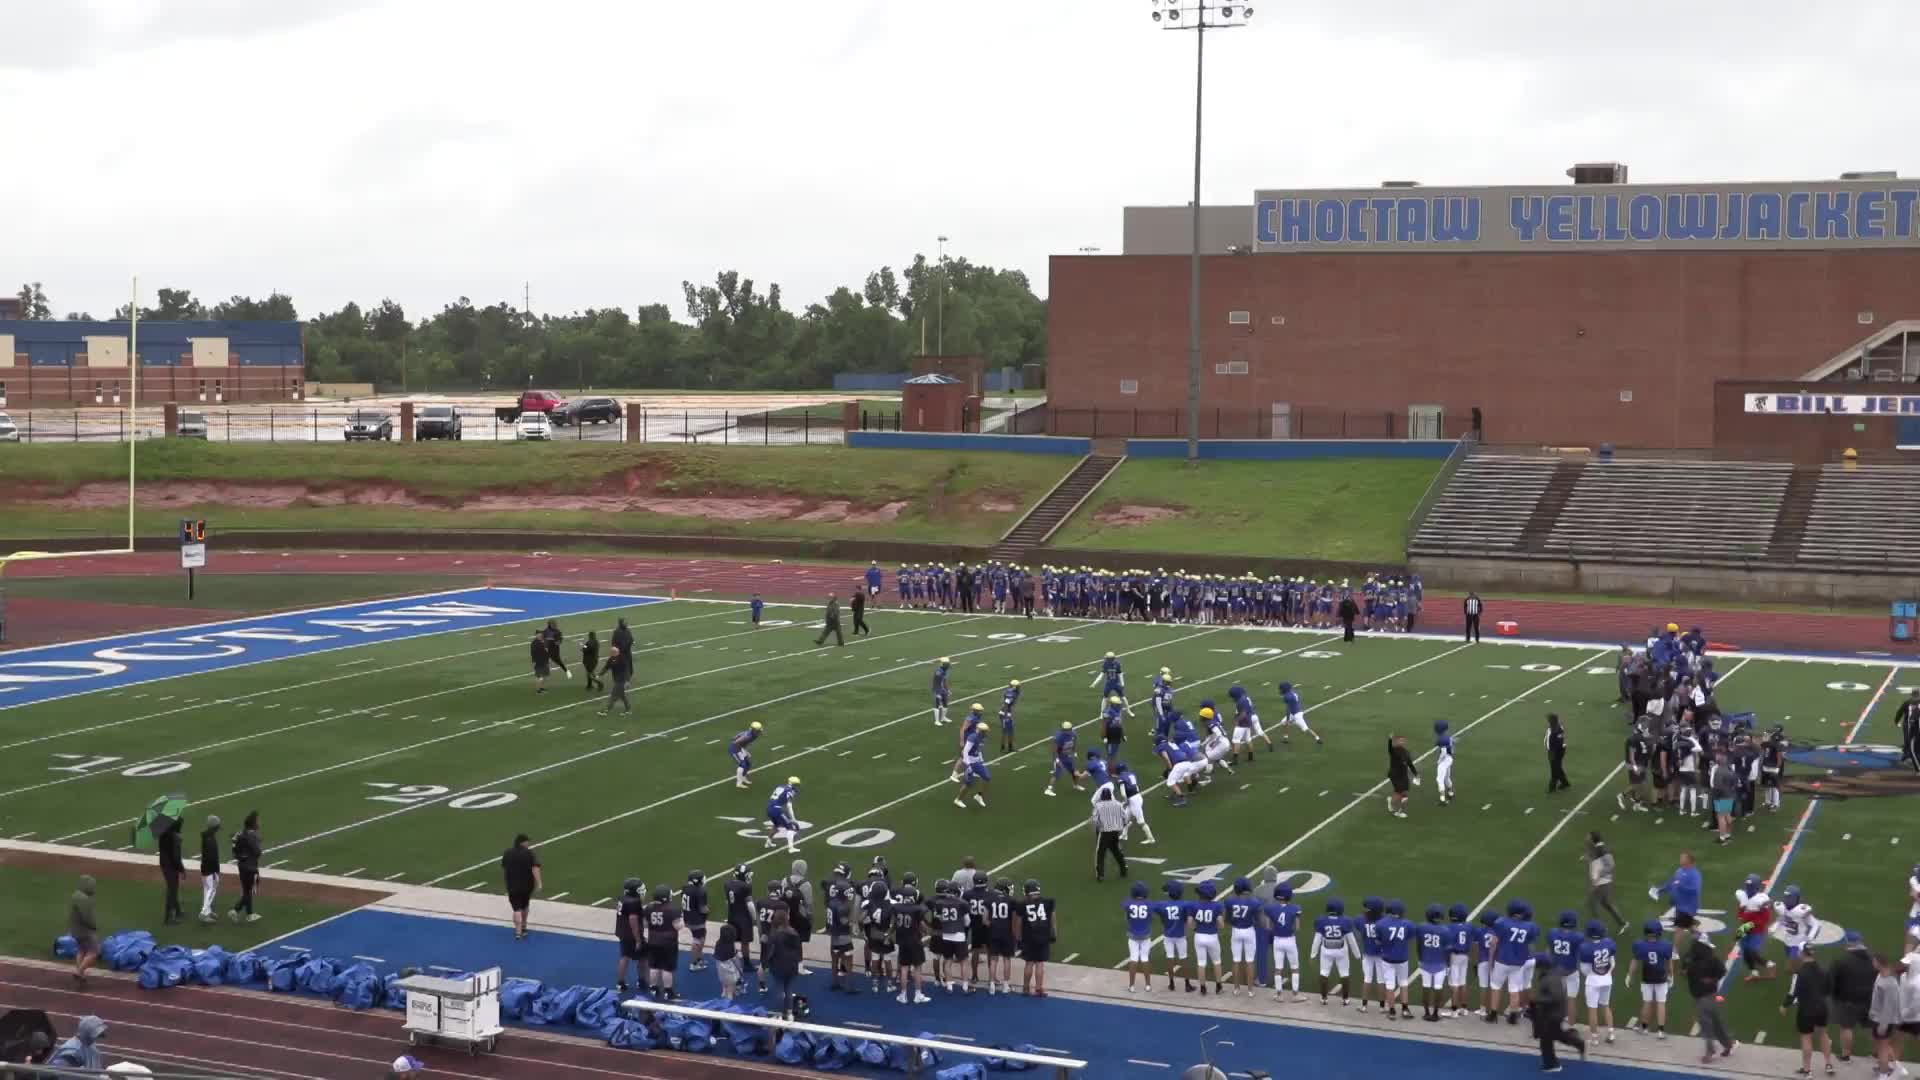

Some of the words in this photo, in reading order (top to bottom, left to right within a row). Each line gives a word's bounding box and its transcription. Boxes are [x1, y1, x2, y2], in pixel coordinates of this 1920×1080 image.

[1256, 197, 1481, 243] CHOCTAW
[1510, 189, 1920, 241] YELLOWJACKET
[1777, 396, 1846, 412] BILL
[942, 907, 958, 920] 23
[991, 902, 1008, 918] 10
[1026, 903, 1047, 921] 54
[1129, 904, 1148, 919] 36
[1165, 905, 1179, 920] 12
[1195, 909, 1213, 923] 40
[1232, 904, 1249, 918] 27
[650, 911, 664, 925] 65
[1277, 912, 1286, 926] 4
[1324, 925, 1342, 938] 25
[1388, 926, 1405, 940] 74
[1459, 931, 1467, 945] 6
[1509, 927, 1527, 943] 73
[1424, 933, 1440, 948] 28
[1553, 939, 1571, 955] 23
[1594, 948, 1610, 963] 22
[1648, 951, 1657, 965] 9
